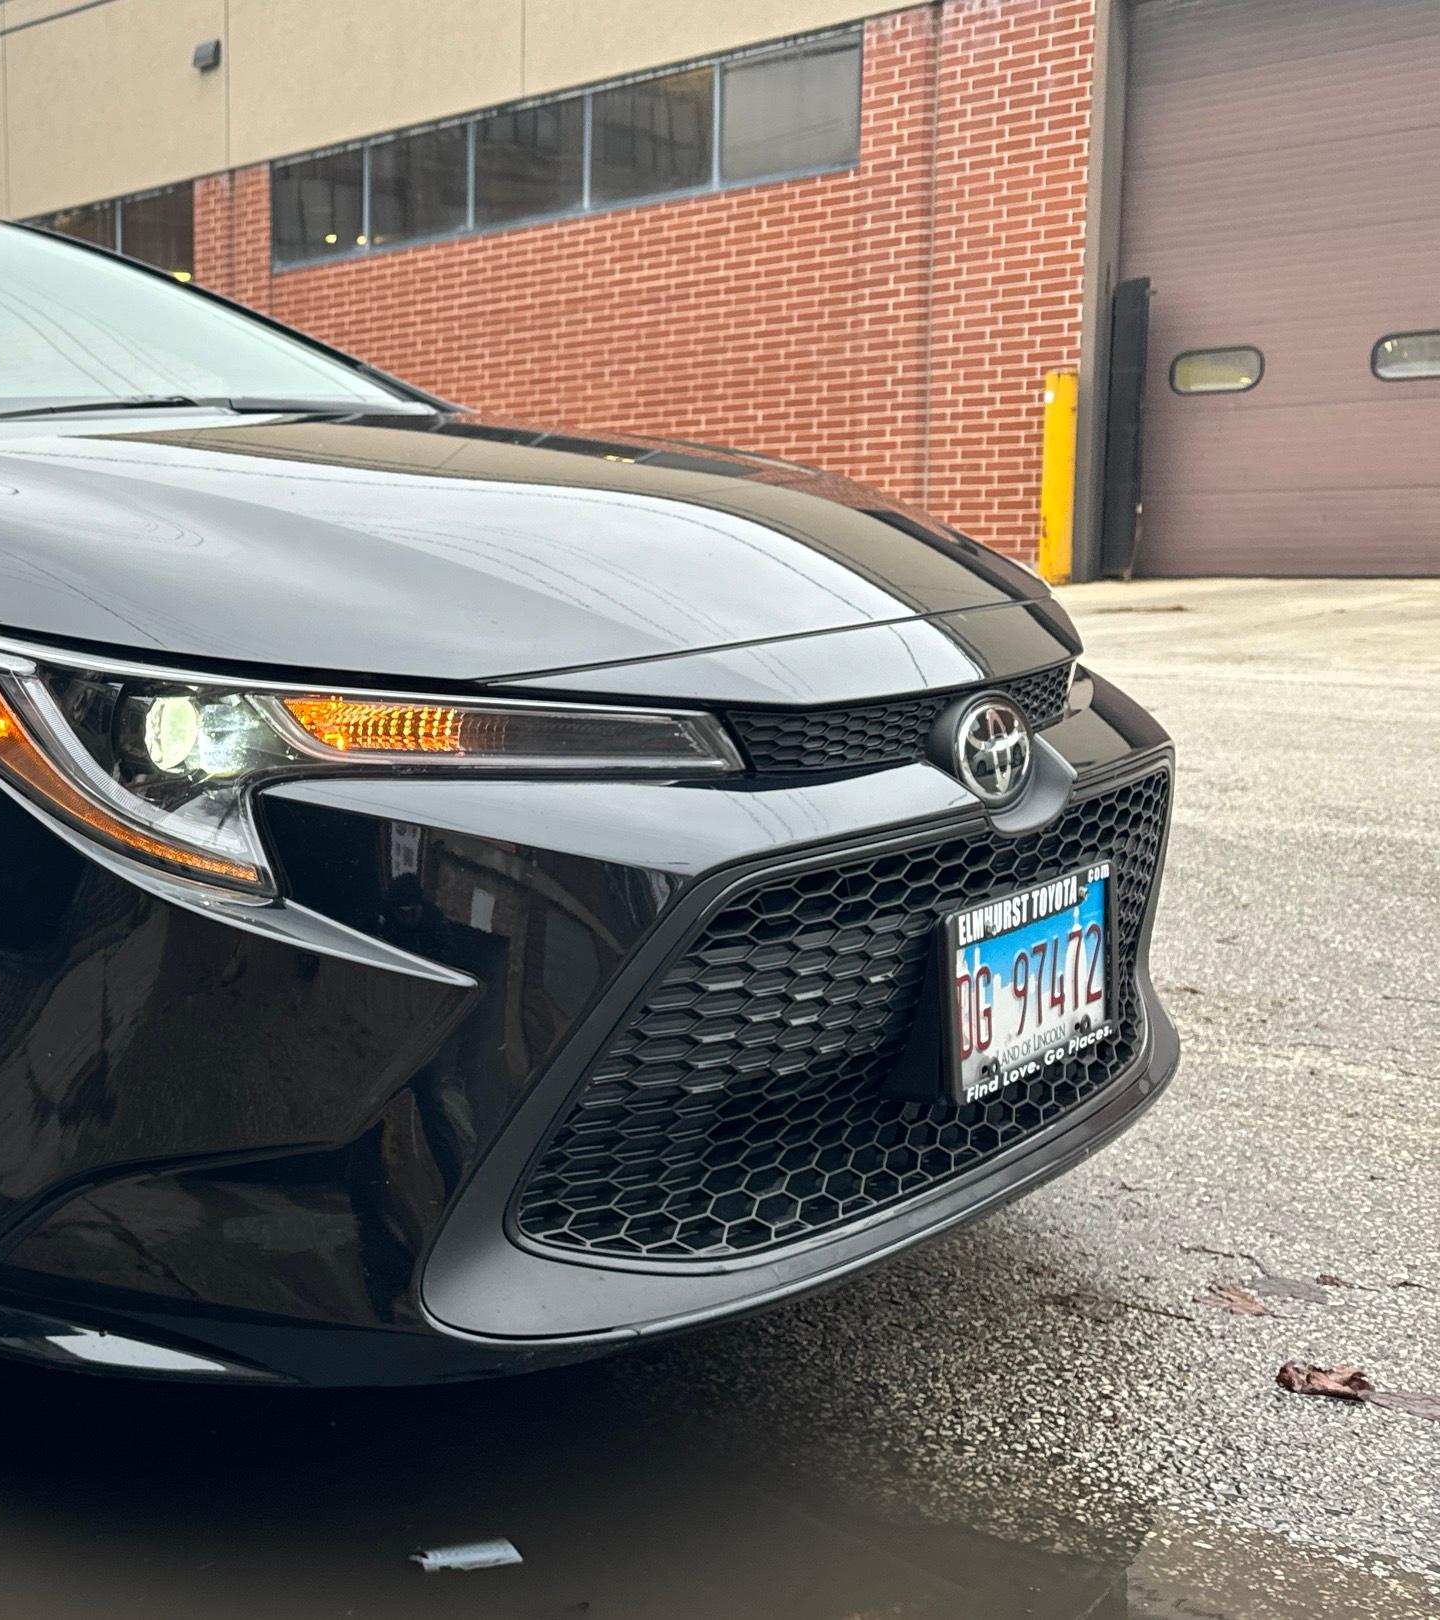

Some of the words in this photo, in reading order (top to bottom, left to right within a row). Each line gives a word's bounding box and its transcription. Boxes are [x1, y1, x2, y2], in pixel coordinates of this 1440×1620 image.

[959, 893, 1029, 946] ELMHURST
[1031, 875, 1077, 920] TOYOTA
[1013, 924, 1103, 1036] 97472
[966, 1075, 999, 1103] Find
[1003, 1060, 1040, 1086] Love.
[1044, 1048, 1065, 1066] Go
[1068, 1025, 1113, 1055] Places.
[1033, 1024, 1066, 1051] LINCOLN
